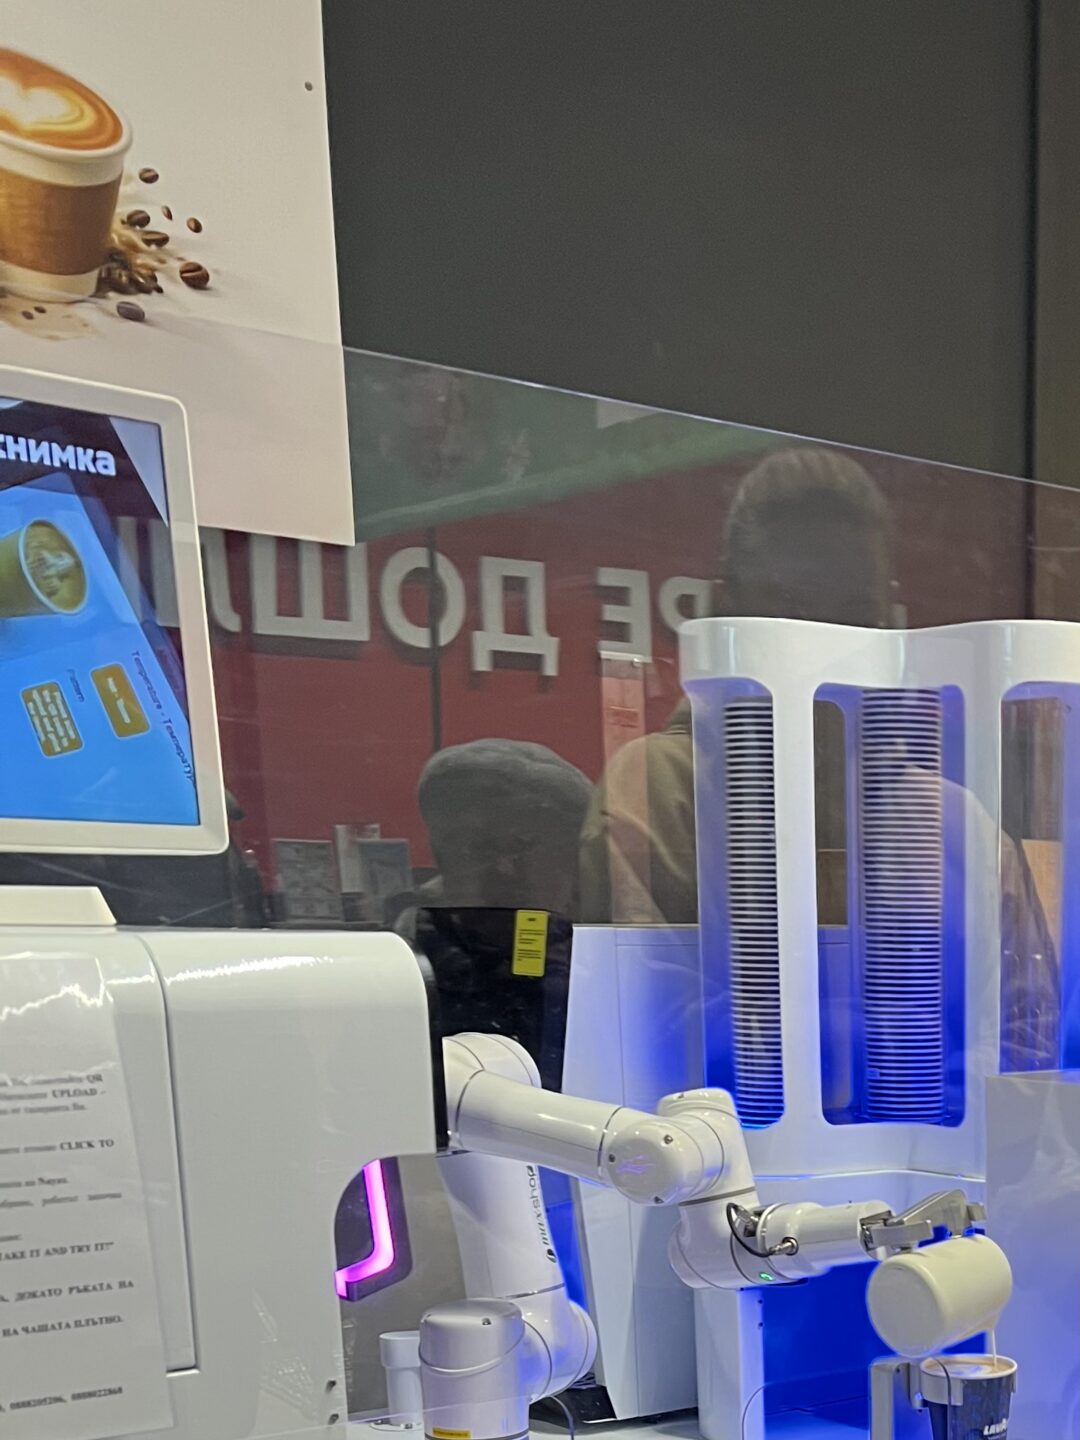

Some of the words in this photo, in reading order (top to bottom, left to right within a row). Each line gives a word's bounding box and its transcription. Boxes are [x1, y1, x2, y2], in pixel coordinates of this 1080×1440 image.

[52, 1088, 98, 1098] UPLOAD
[60, 1140, 95, 1150] CLICK
[98, 1139, 115, 1148] TO
[44, 1246, 68, 1257] AND
[70, 1244, 91, 1254] TRY
[119, 1280, 135, 1289] НА
[21, 1321, 72, 1335] ЧАШАТА
